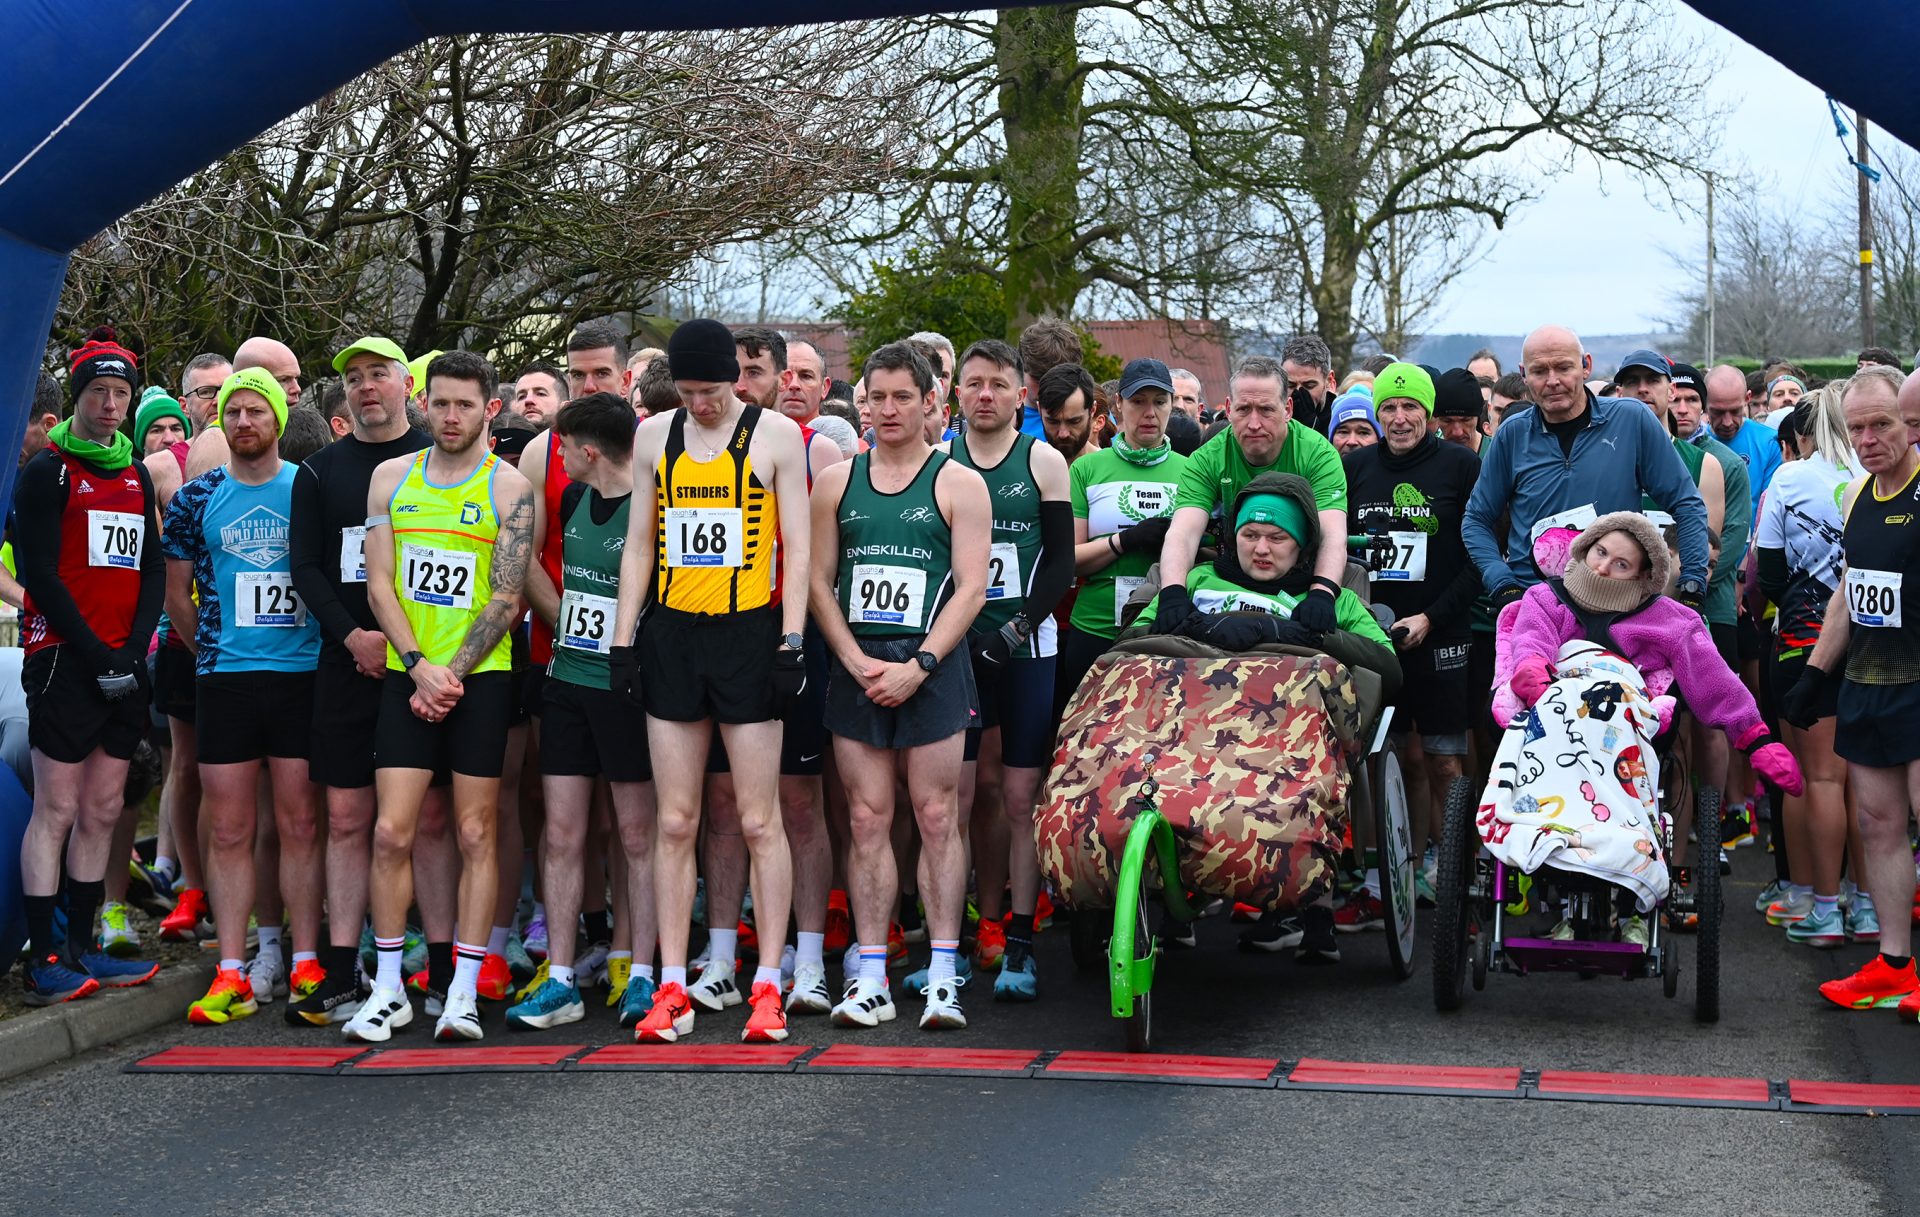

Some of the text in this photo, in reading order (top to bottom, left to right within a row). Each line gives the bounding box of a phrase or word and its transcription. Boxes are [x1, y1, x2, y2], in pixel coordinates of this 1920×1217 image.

[736, 427, 749, 449] soar
[676, 485, 730, 499] STRIDERS
[1136, 490, 1162, 499] Team
[1138, 501, 1160, 509] Kerr
[241, 519, 281, 529] DONEGAL
[102, 525, 138, 557] 708
[682, 523, 727, 554] 168
[847, 545, 932, 560] ENNISKILLEN
[408, 559, 468, 596] 1232
[255, 586, 298, 614] 125
[861, 579, 910, 612] 906
[1849, 582, 1895, 616] 1280
[1240, 601, 1266, 613] Team
[565, 605, 605, 640] 153
[323, 988, 358, 1010] BROOKS
